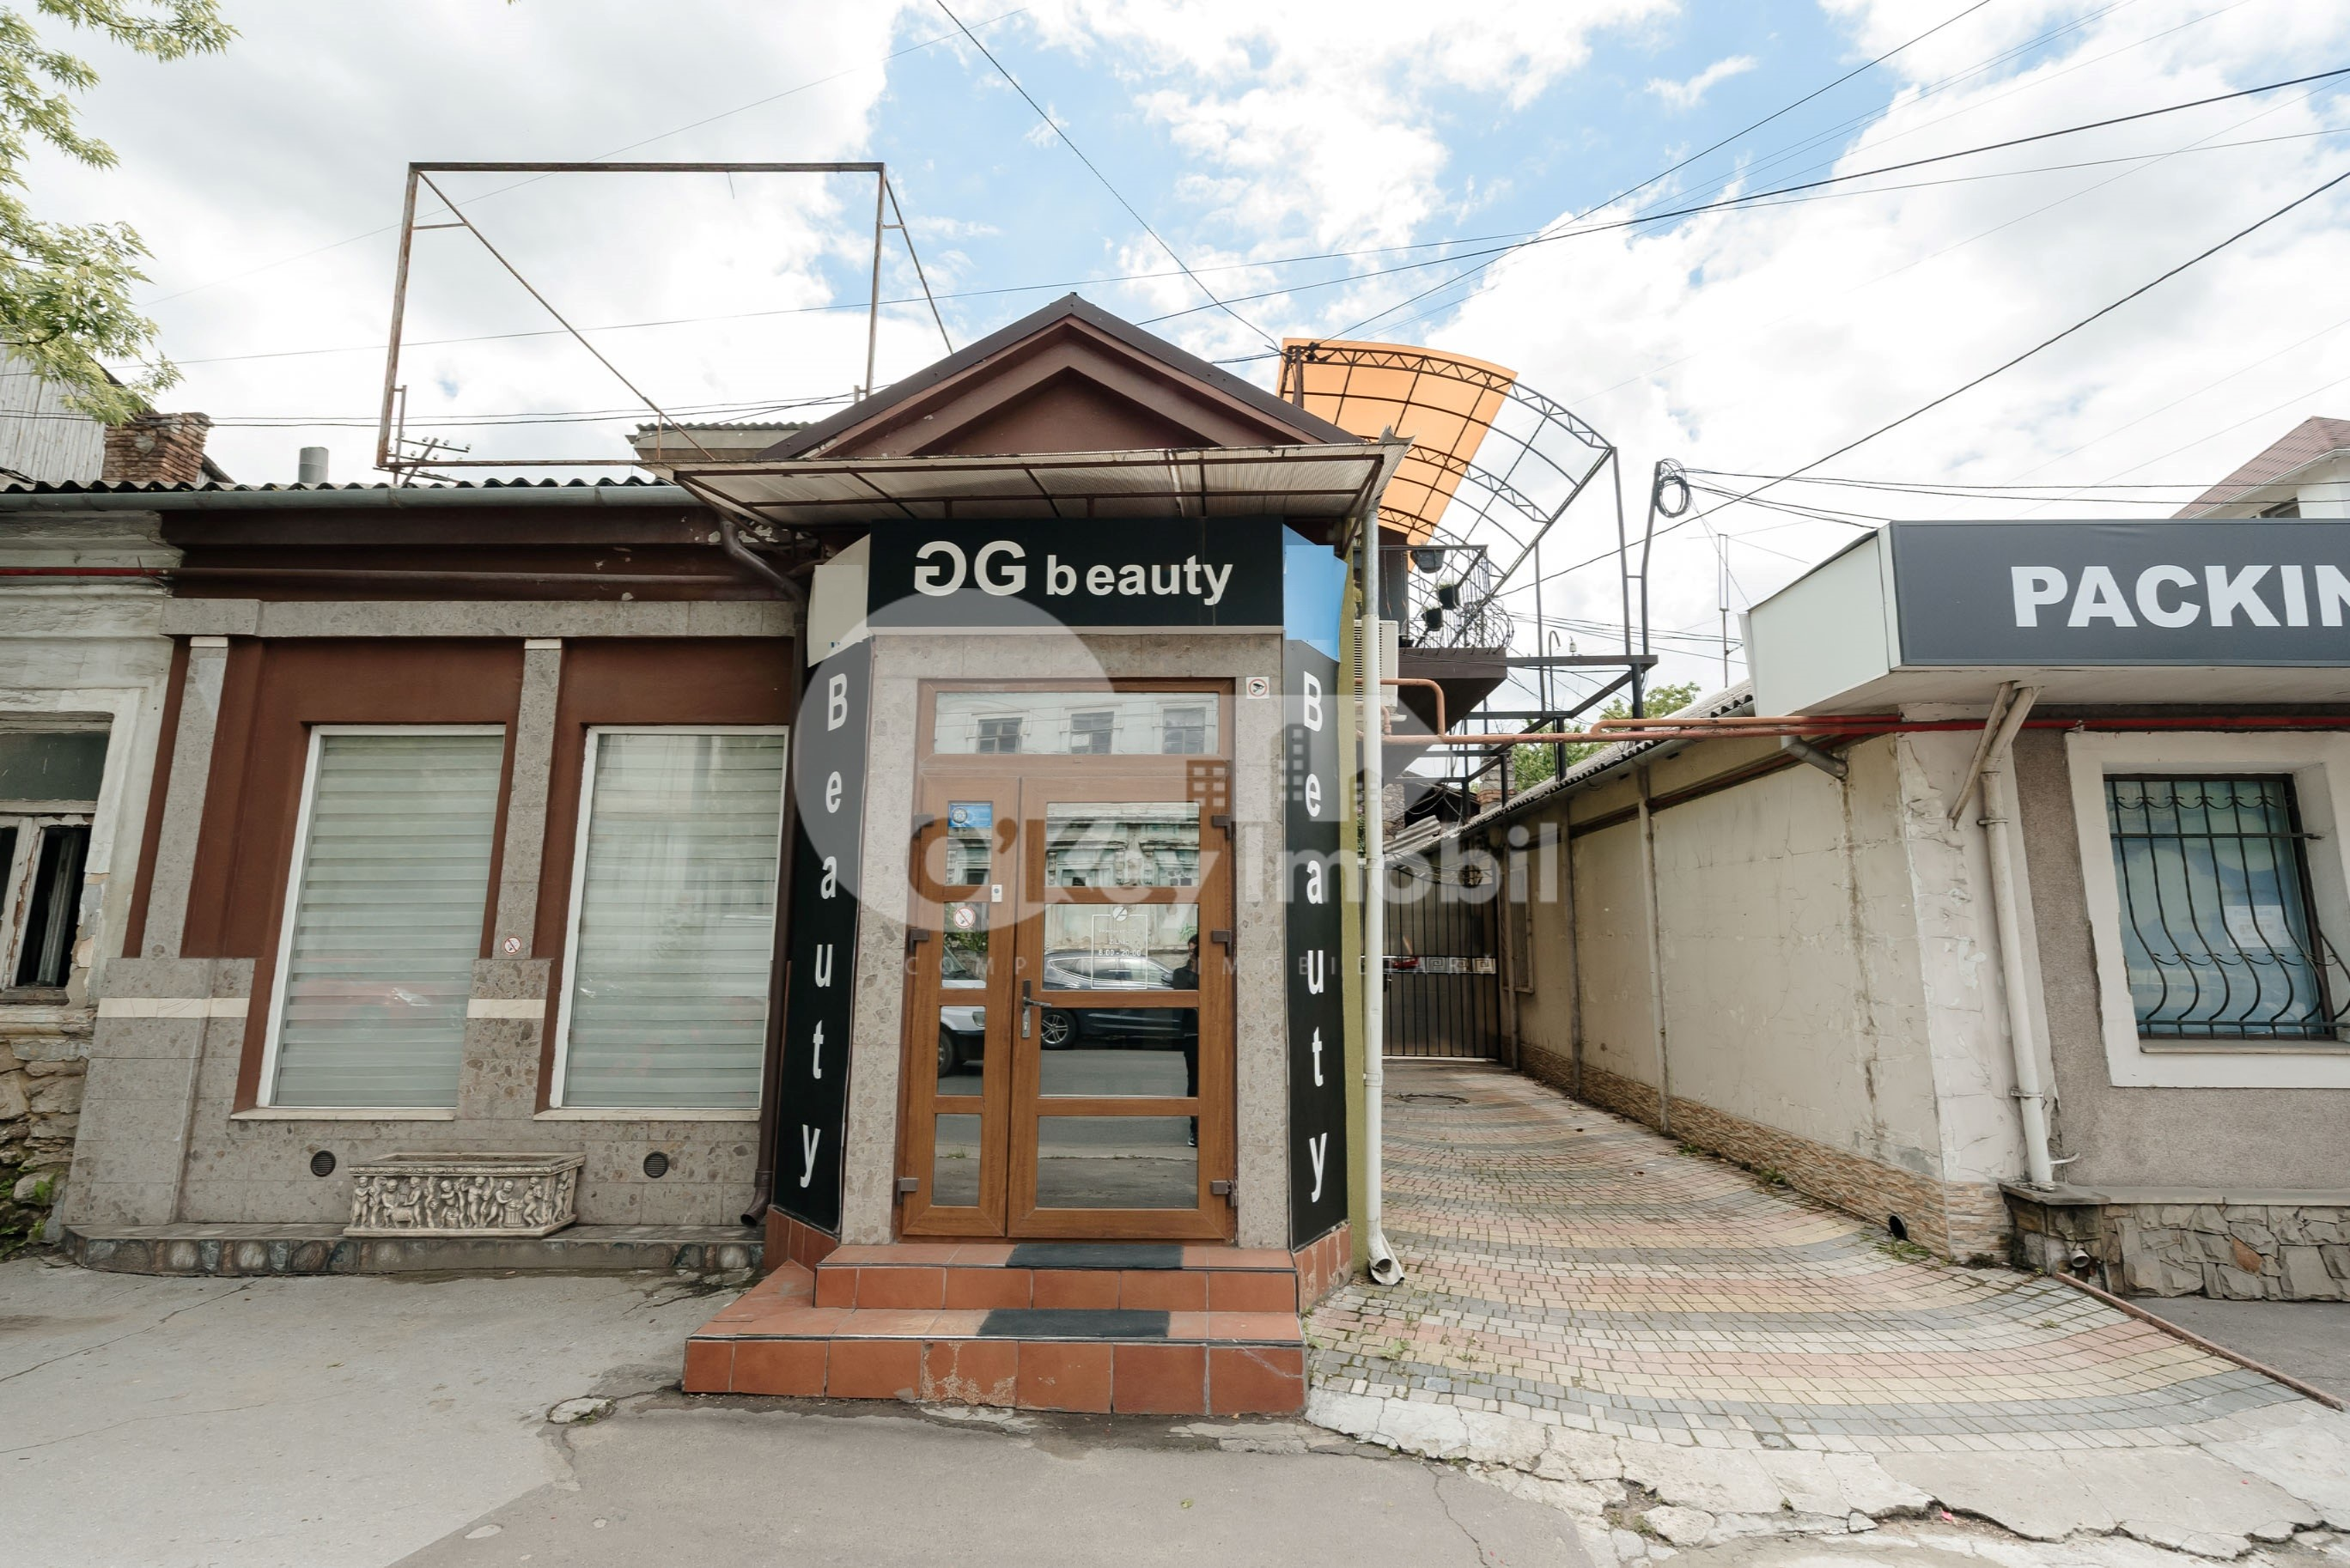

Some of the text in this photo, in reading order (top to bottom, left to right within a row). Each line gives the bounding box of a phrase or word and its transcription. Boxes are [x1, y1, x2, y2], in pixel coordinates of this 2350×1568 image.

[1046, 554, 1233, 606] beauty
[799, 672, 849, 1189] Beauty
[1302, 671, 1328, 1204] Beauty
